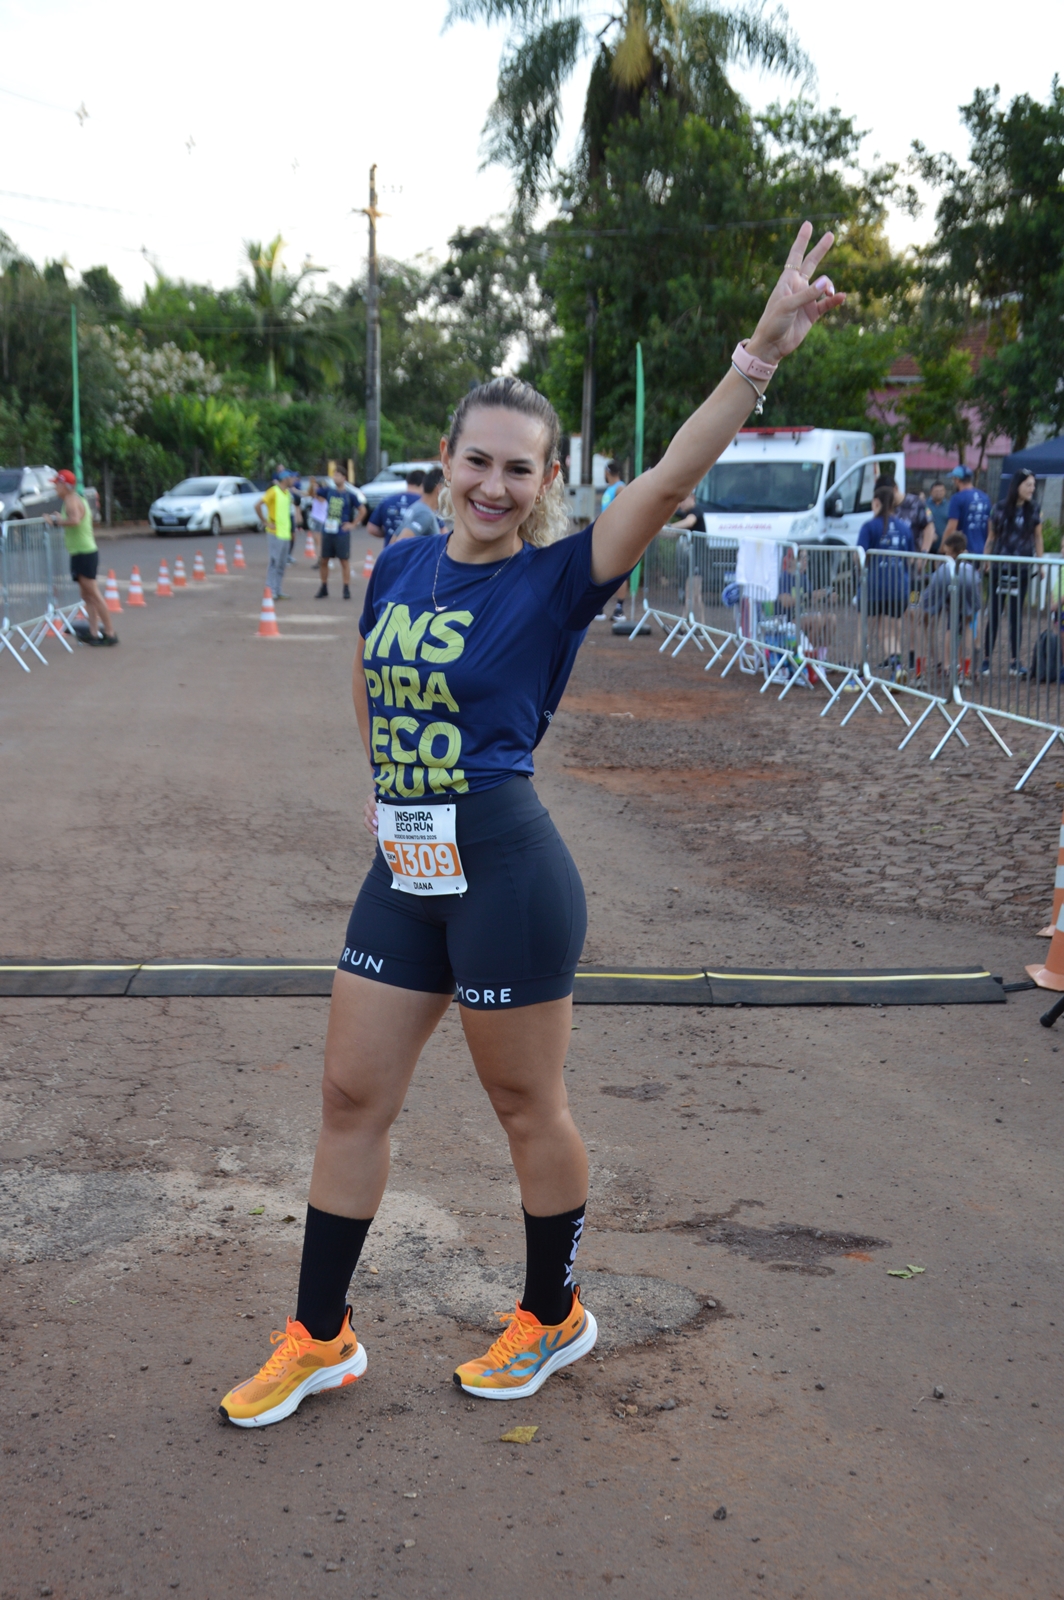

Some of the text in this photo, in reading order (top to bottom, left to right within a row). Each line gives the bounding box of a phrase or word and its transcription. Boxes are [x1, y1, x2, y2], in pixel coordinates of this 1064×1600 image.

[364, 602, 474, 664] INS
[364, 665, 460, 713] PIRA
[372, 715, 462, 769] ECO
[374, 763, 470, 798] RUN
[396, 822, 433, 832] ECO RUN
[394, 843, 456, 876] 1309
[413, 882, 433, 890] DIANA
[342, 947, 384, 974] RUN
[456, 982, 512, 1004] MORE
